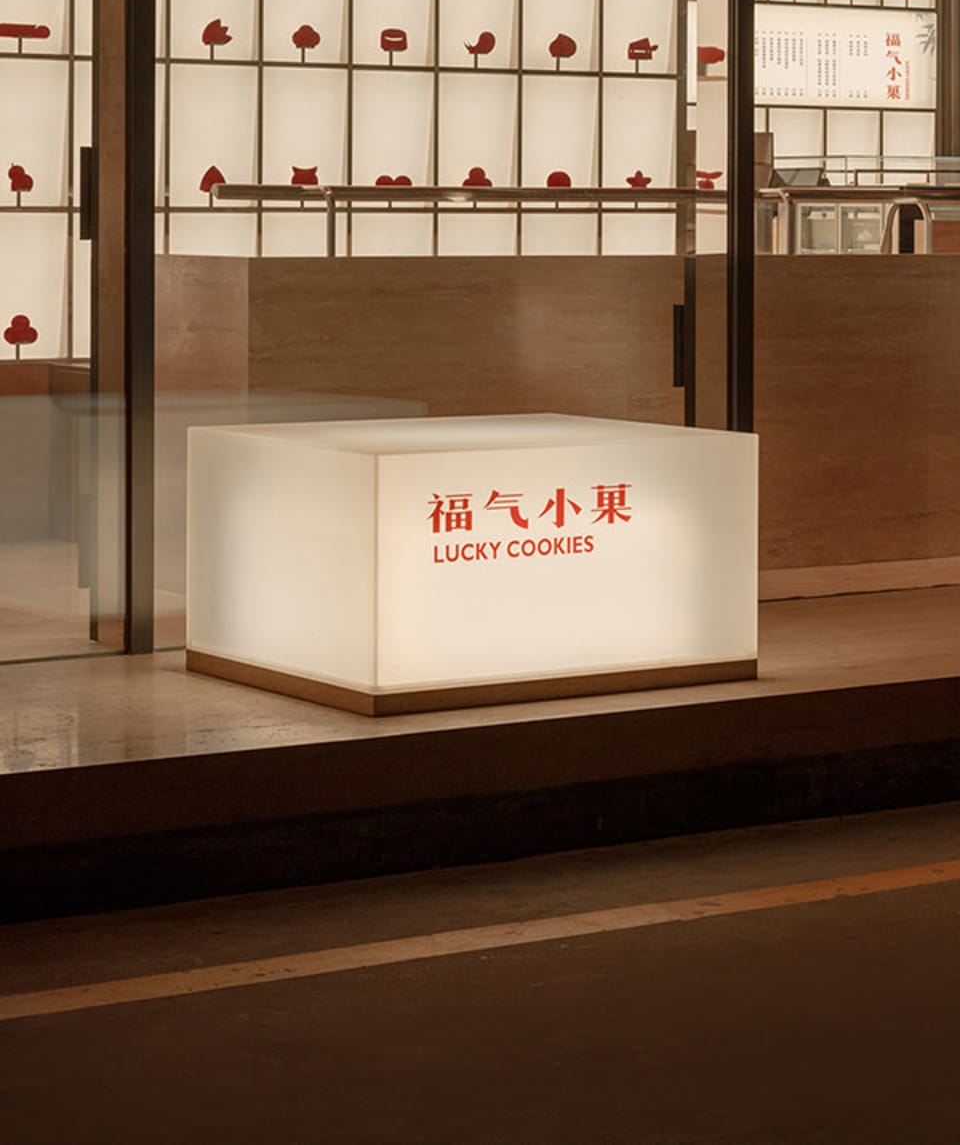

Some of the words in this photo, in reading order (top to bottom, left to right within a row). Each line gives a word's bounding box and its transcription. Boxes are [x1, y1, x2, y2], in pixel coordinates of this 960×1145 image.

[426, 483, 632, 533] 福气小菓
[433, 541, 501, 563] LUCKY
[506, 535, 594, 559] COOKIES
